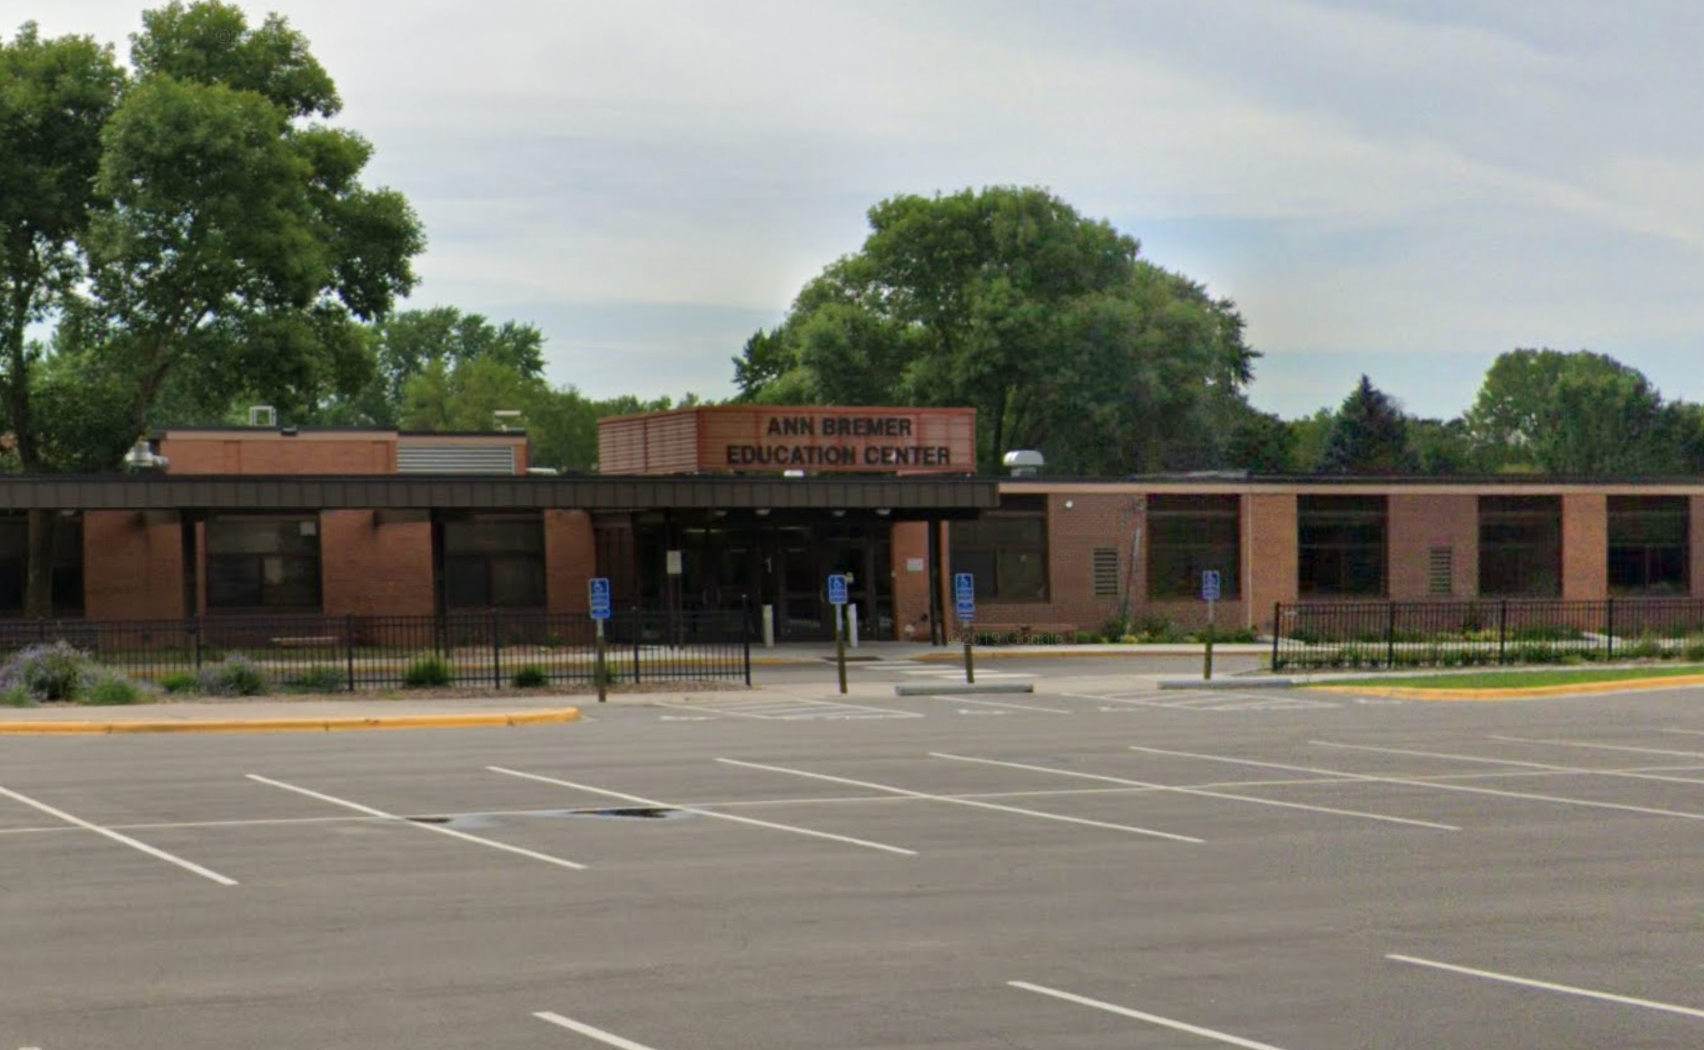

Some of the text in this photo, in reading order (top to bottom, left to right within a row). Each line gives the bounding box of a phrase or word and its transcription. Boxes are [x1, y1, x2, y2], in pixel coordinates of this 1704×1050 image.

[767, 417, 912, 436] ANN BREMER
[726, 445, 950, 465] EDUCATION CENTER
